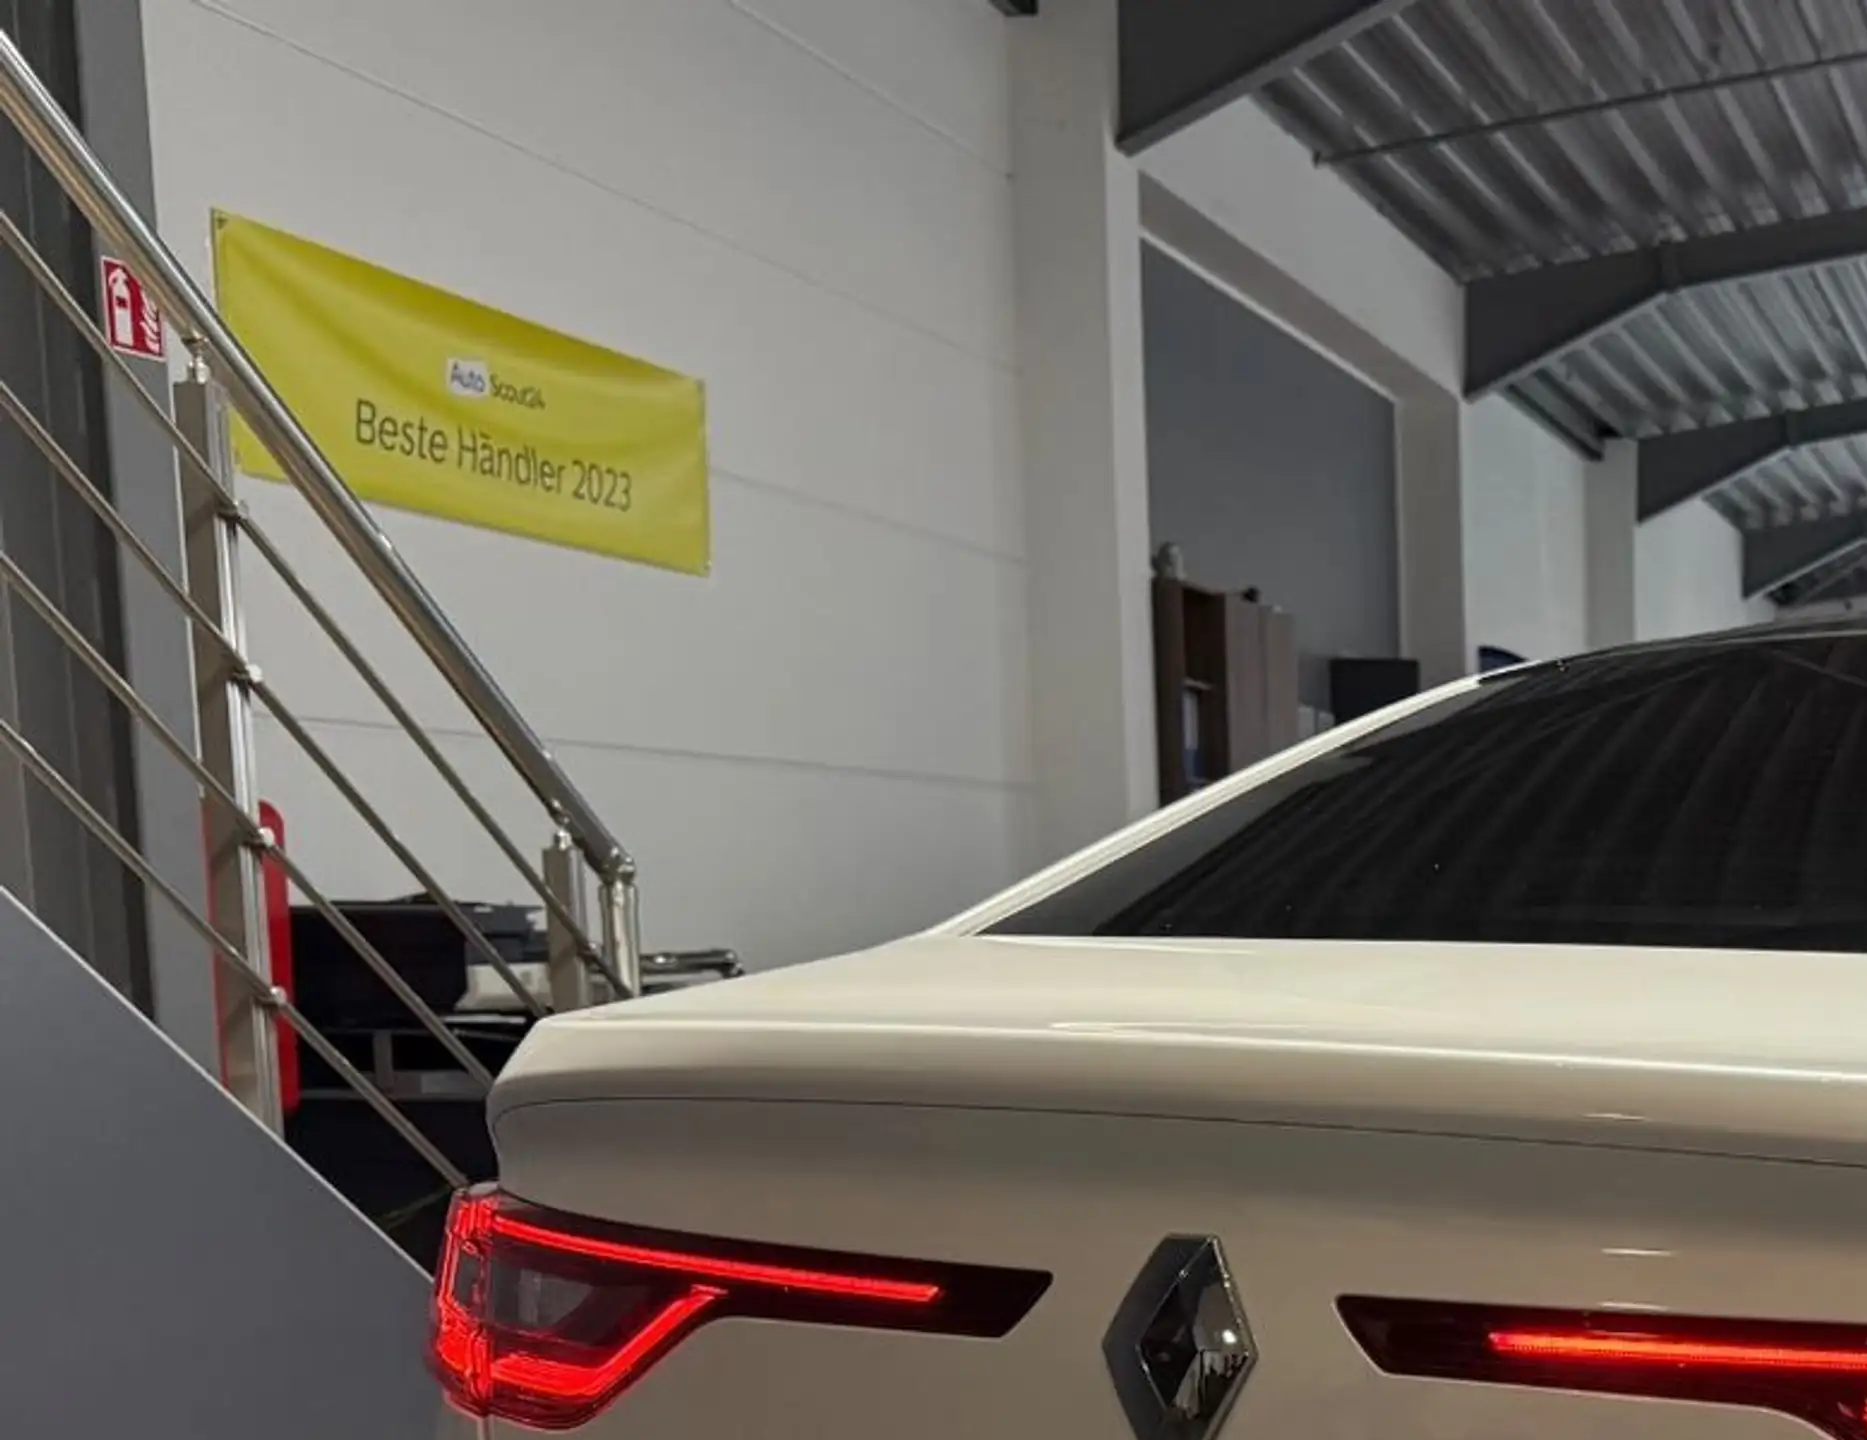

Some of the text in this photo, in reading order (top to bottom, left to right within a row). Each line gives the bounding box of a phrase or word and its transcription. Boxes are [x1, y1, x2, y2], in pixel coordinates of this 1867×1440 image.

[449, 361, 486, 394] Auto
[355, 399, 633, 513] Beste Händler 2023
